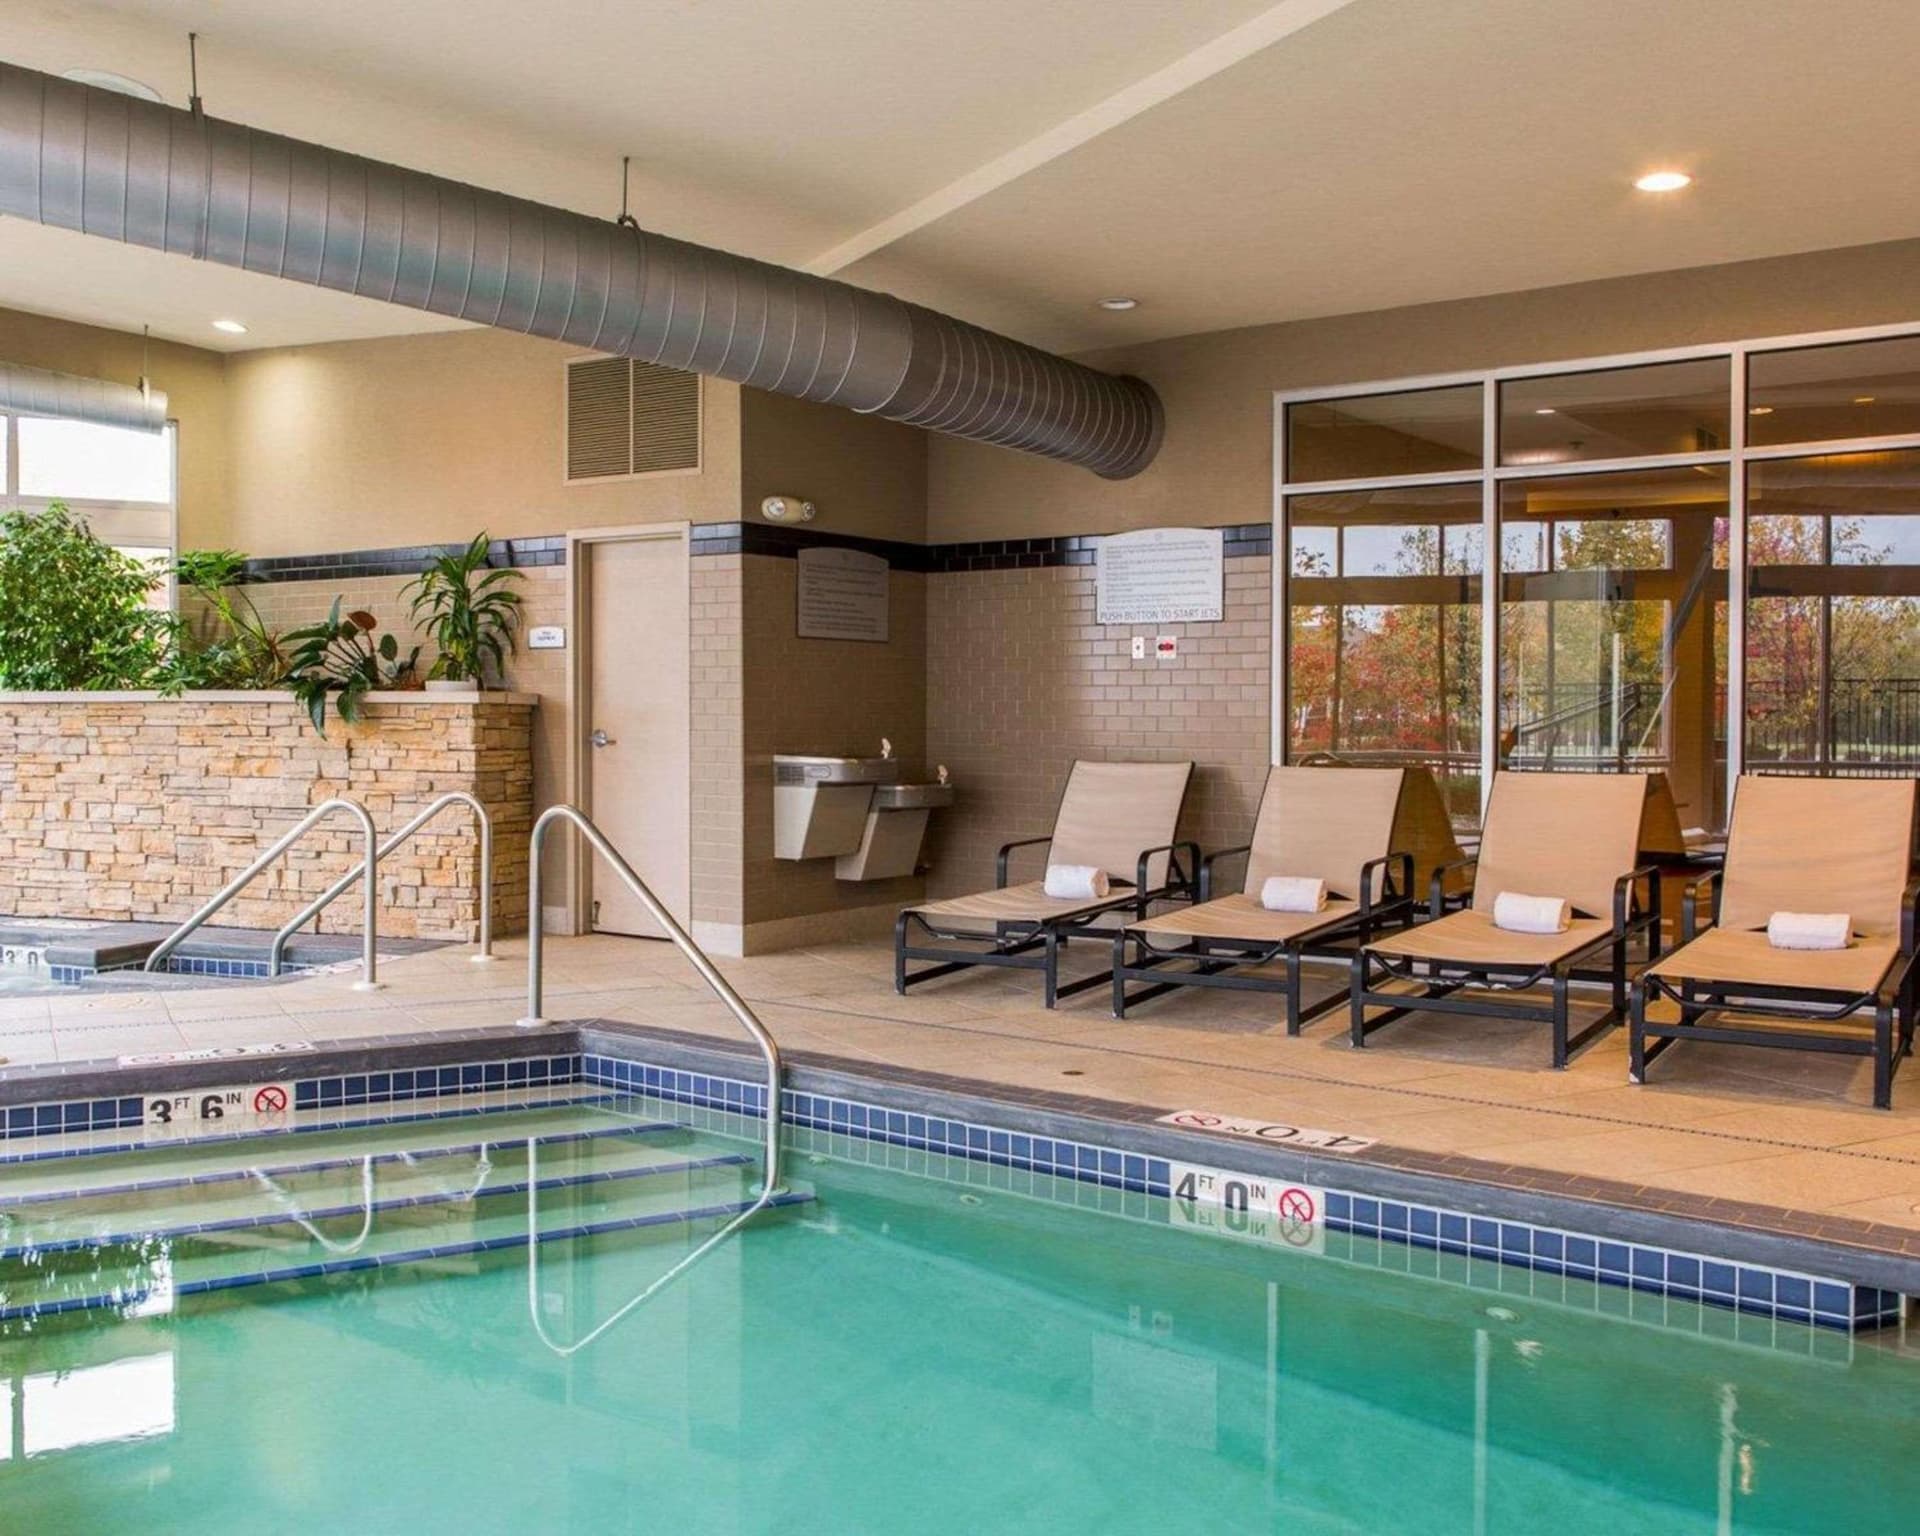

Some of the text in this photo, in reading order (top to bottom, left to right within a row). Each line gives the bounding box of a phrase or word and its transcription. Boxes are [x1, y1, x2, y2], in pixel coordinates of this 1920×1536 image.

[1100, 608, 1220, 621] PUSH BUTTON TO START JETS
[150, 1092, 241, 1123] 3 FT 6 IN
[1323, 1136, 1369, 1148] 4
[1176, 1172, 1266, 1211] 4 FT 0 IN
